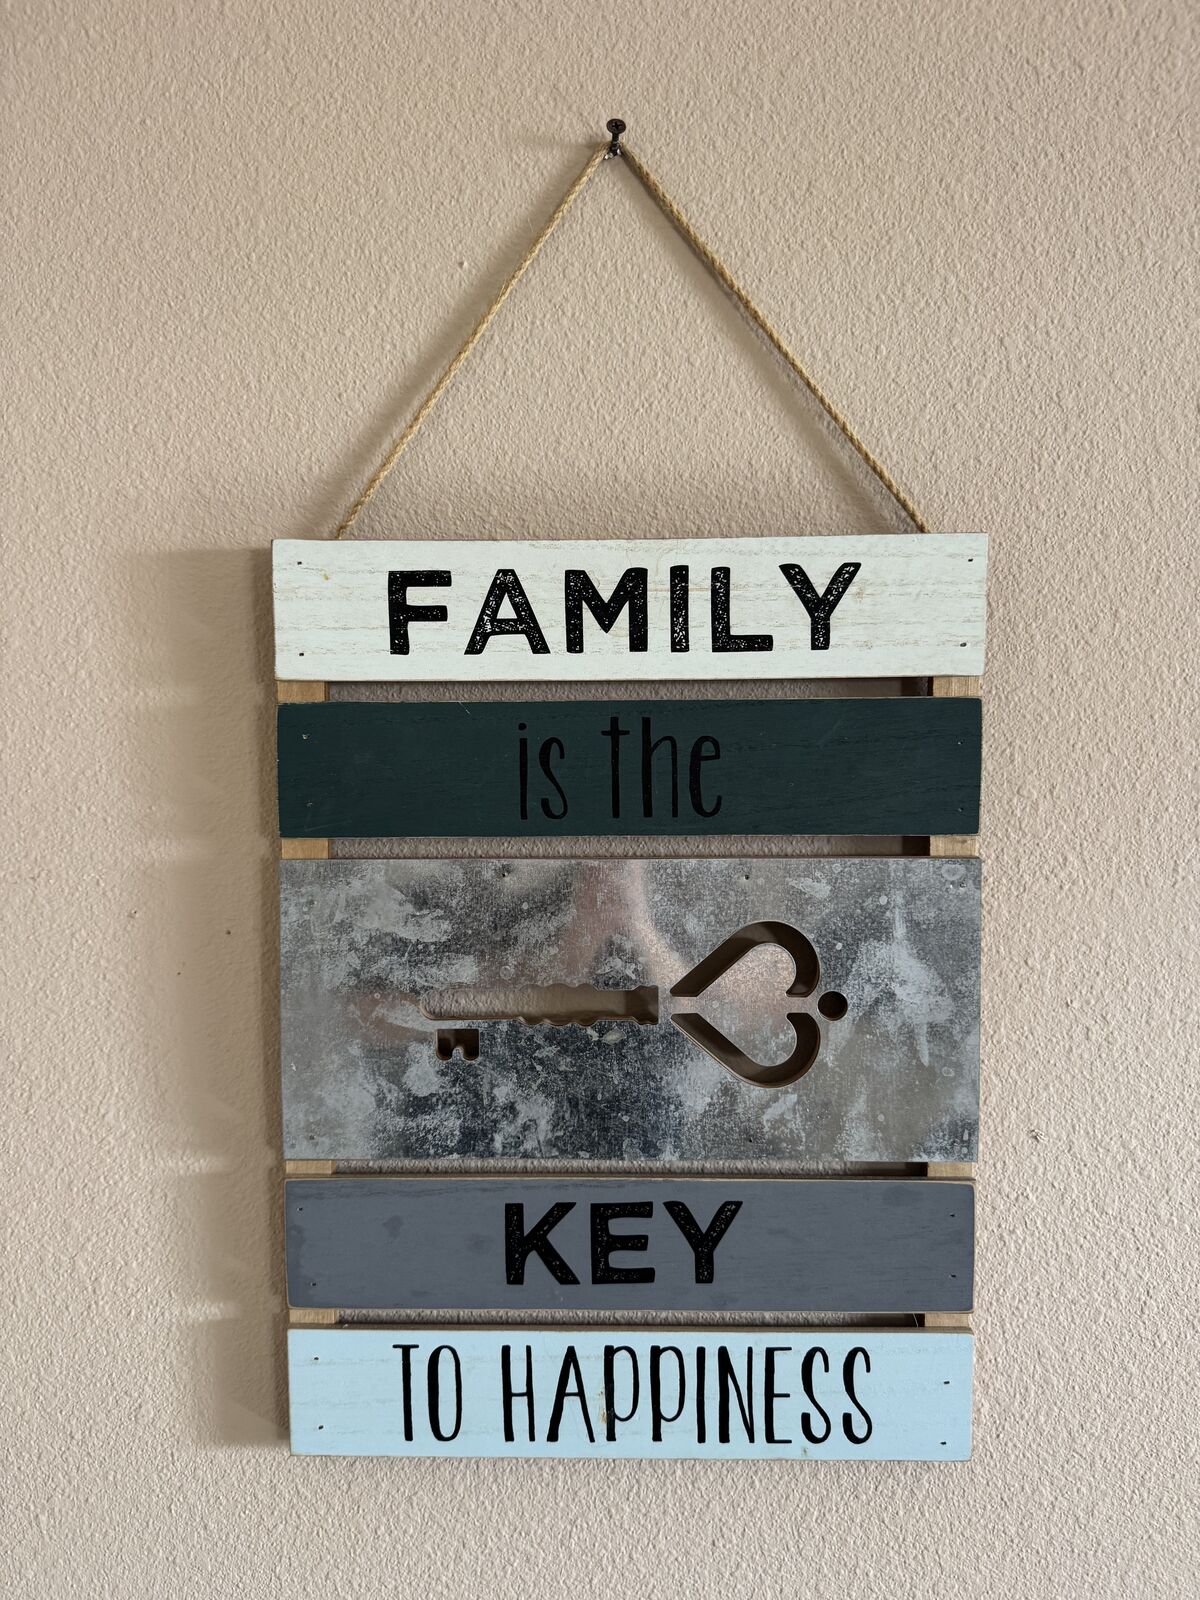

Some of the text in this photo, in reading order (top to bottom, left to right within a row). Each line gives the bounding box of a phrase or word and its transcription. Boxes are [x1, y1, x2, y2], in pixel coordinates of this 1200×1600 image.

[388, 563, 861, 655] FAMILY
[518, 716, 722, 820] is the
[505, 1201, 743, 1285] KEY
[393, 1345, 873, 1444] TO HAPPINESS
